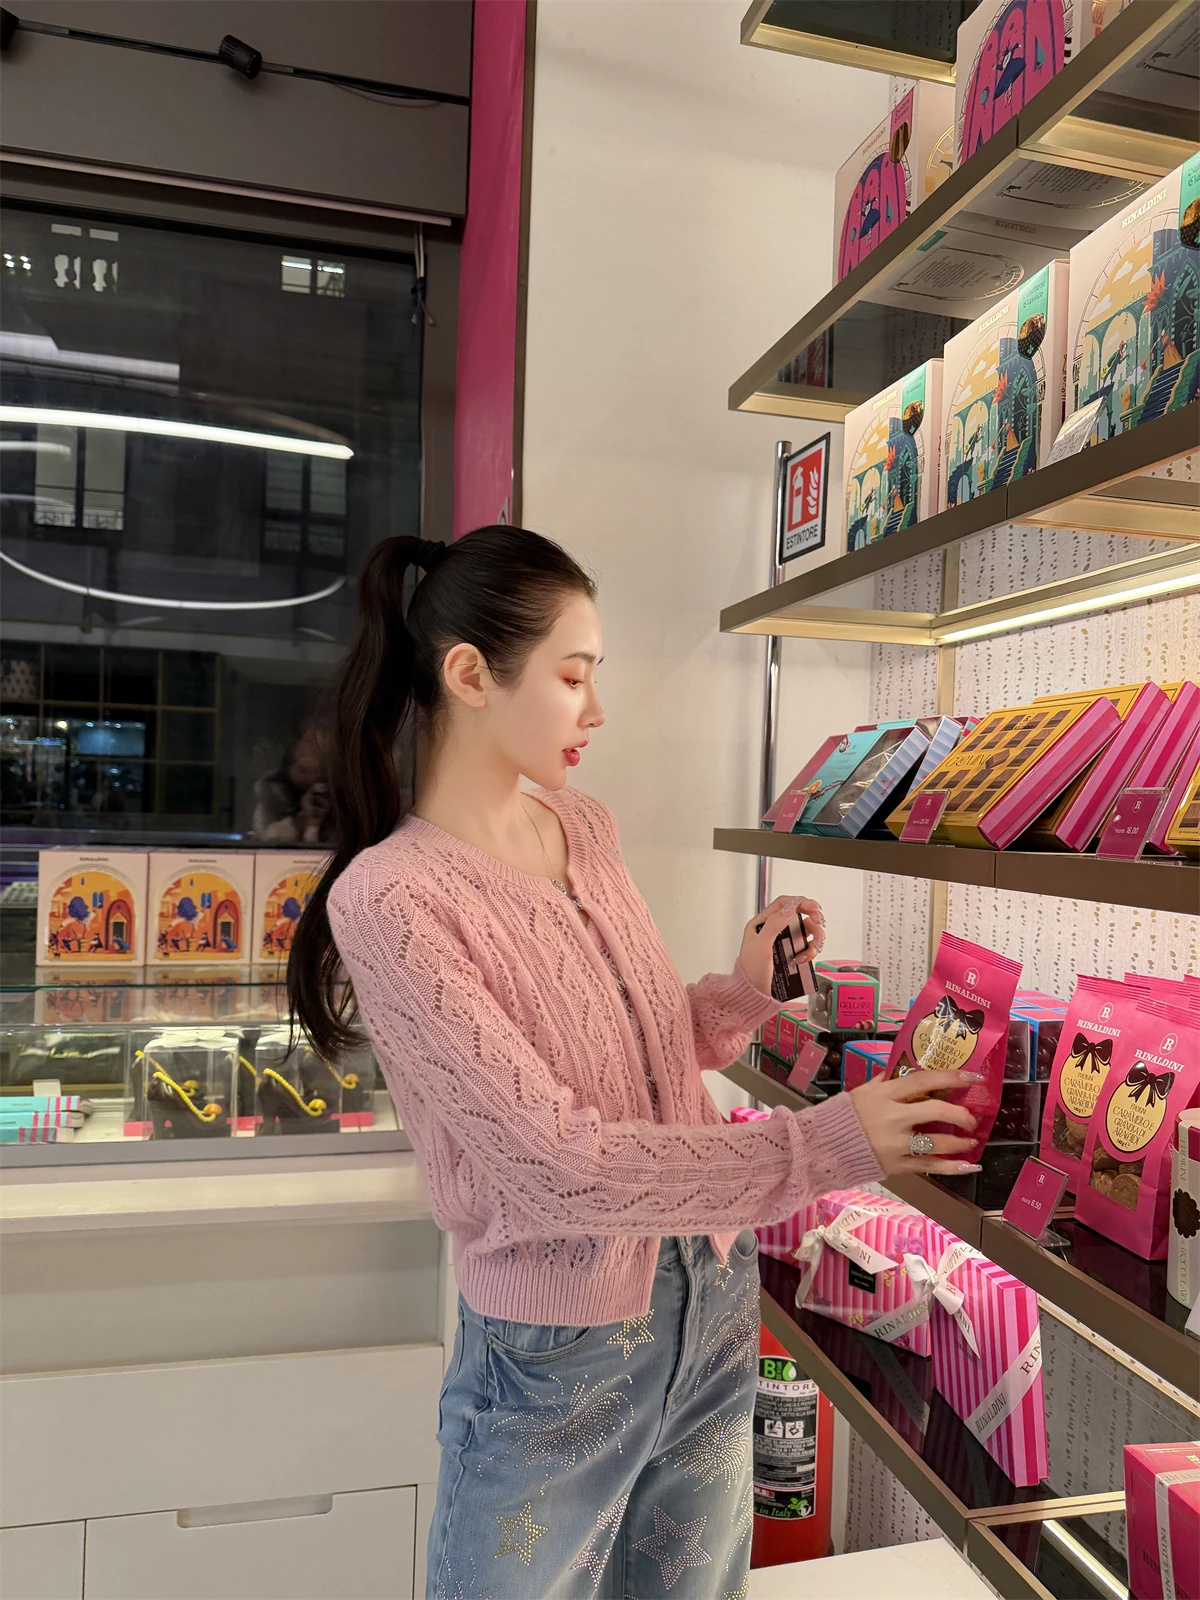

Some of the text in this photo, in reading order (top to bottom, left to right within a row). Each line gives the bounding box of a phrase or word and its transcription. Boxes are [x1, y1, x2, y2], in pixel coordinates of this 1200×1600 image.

[1121, 188, 1168, 230] RINALDINI
[786, 523, 819, 550] ESTINTORE
[966, 971, 977, 986] R
[945, 980, 992, 1010] RINALDINI
[1101, 1007, 1111, 1019] R
[1077, 1019, 1122, 1038] RINALDINI
[1162, 1037, 1173, 1051] R
[1134, 1049, 1185, 1073] RINALDINI
[975, 1392, 1008, 1434] RINALDINI
[771, 1508, 792, 1519] Italy
